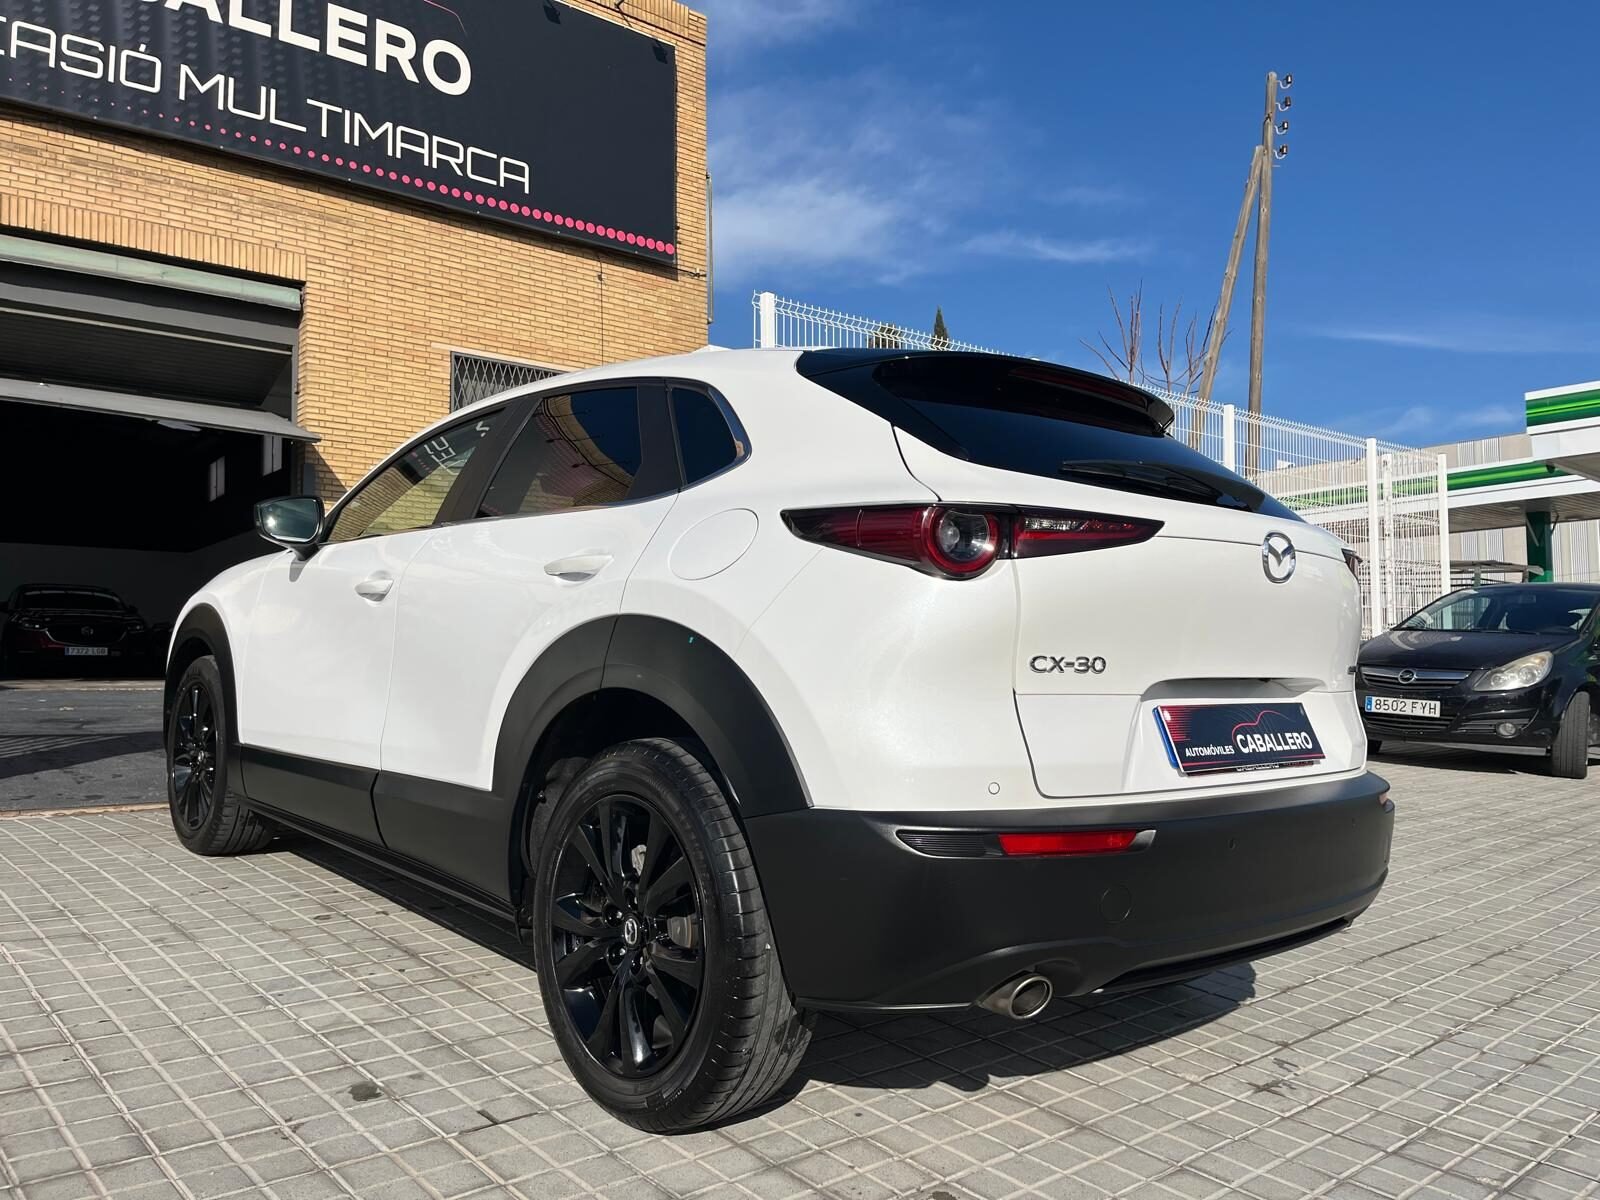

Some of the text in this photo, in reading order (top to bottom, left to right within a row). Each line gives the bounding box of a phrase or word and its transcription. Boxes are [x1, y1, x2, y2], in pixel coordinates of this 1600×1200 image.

[0, 15, 530, 194] ASIÓ MULTIMARCA
[1029, 655, 1107, 674] CX-30
[1374, 698, 1437, 715] 8502 FYH
[1185, 731, 1313, 757] AUTOMÓVILES CABALLERO
